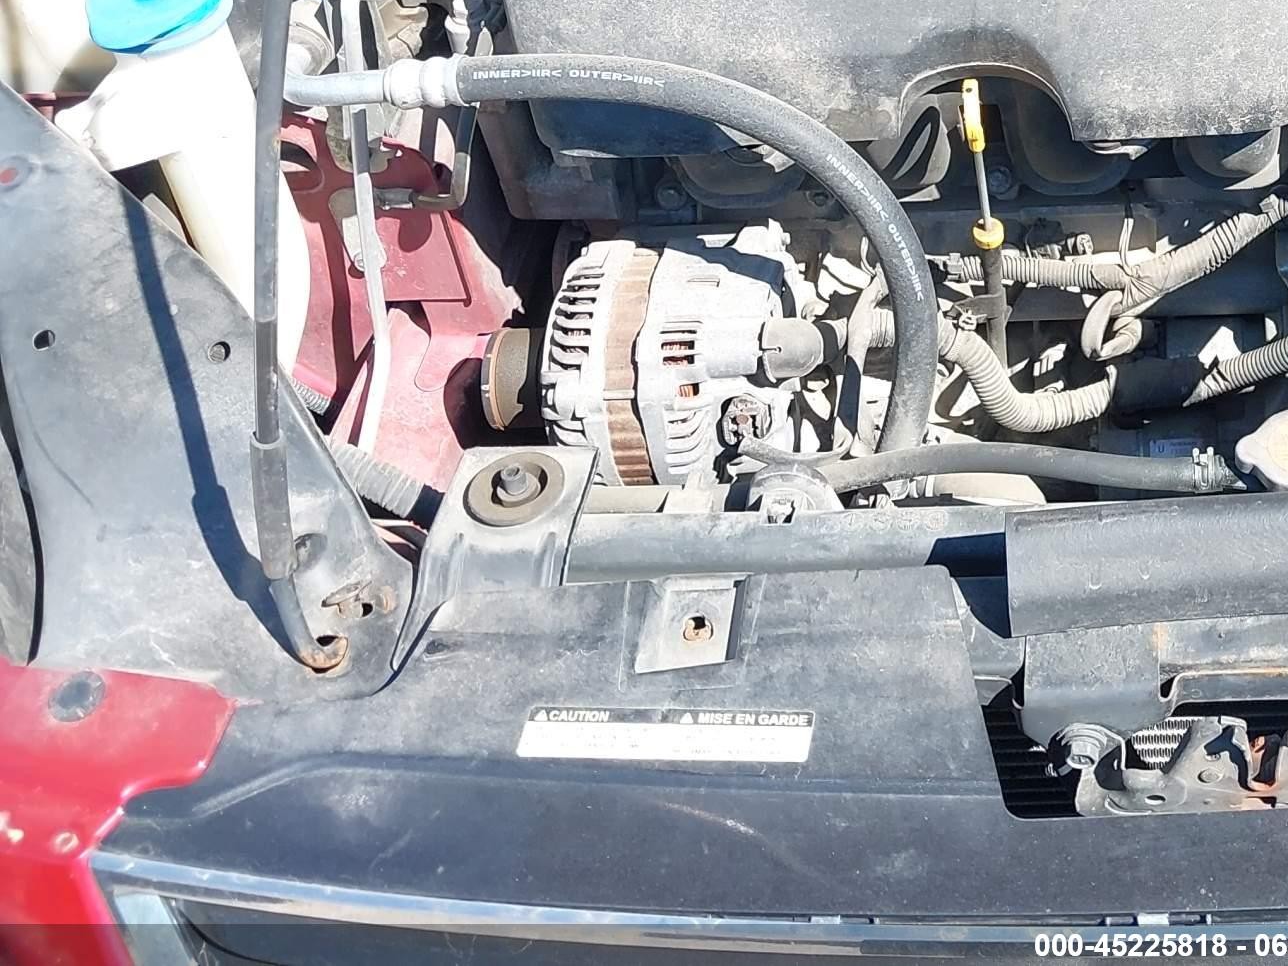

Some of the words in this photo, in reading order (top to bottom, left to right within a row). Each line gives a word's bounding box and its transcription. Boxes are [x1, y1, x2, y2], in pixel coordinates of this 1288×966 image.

[548, 710, 610, 722] CAUTION
[698, 712, 733, 725] MISE
[736, 713, 755, 725] EN
[758, 713, 810, 726] GARDE
